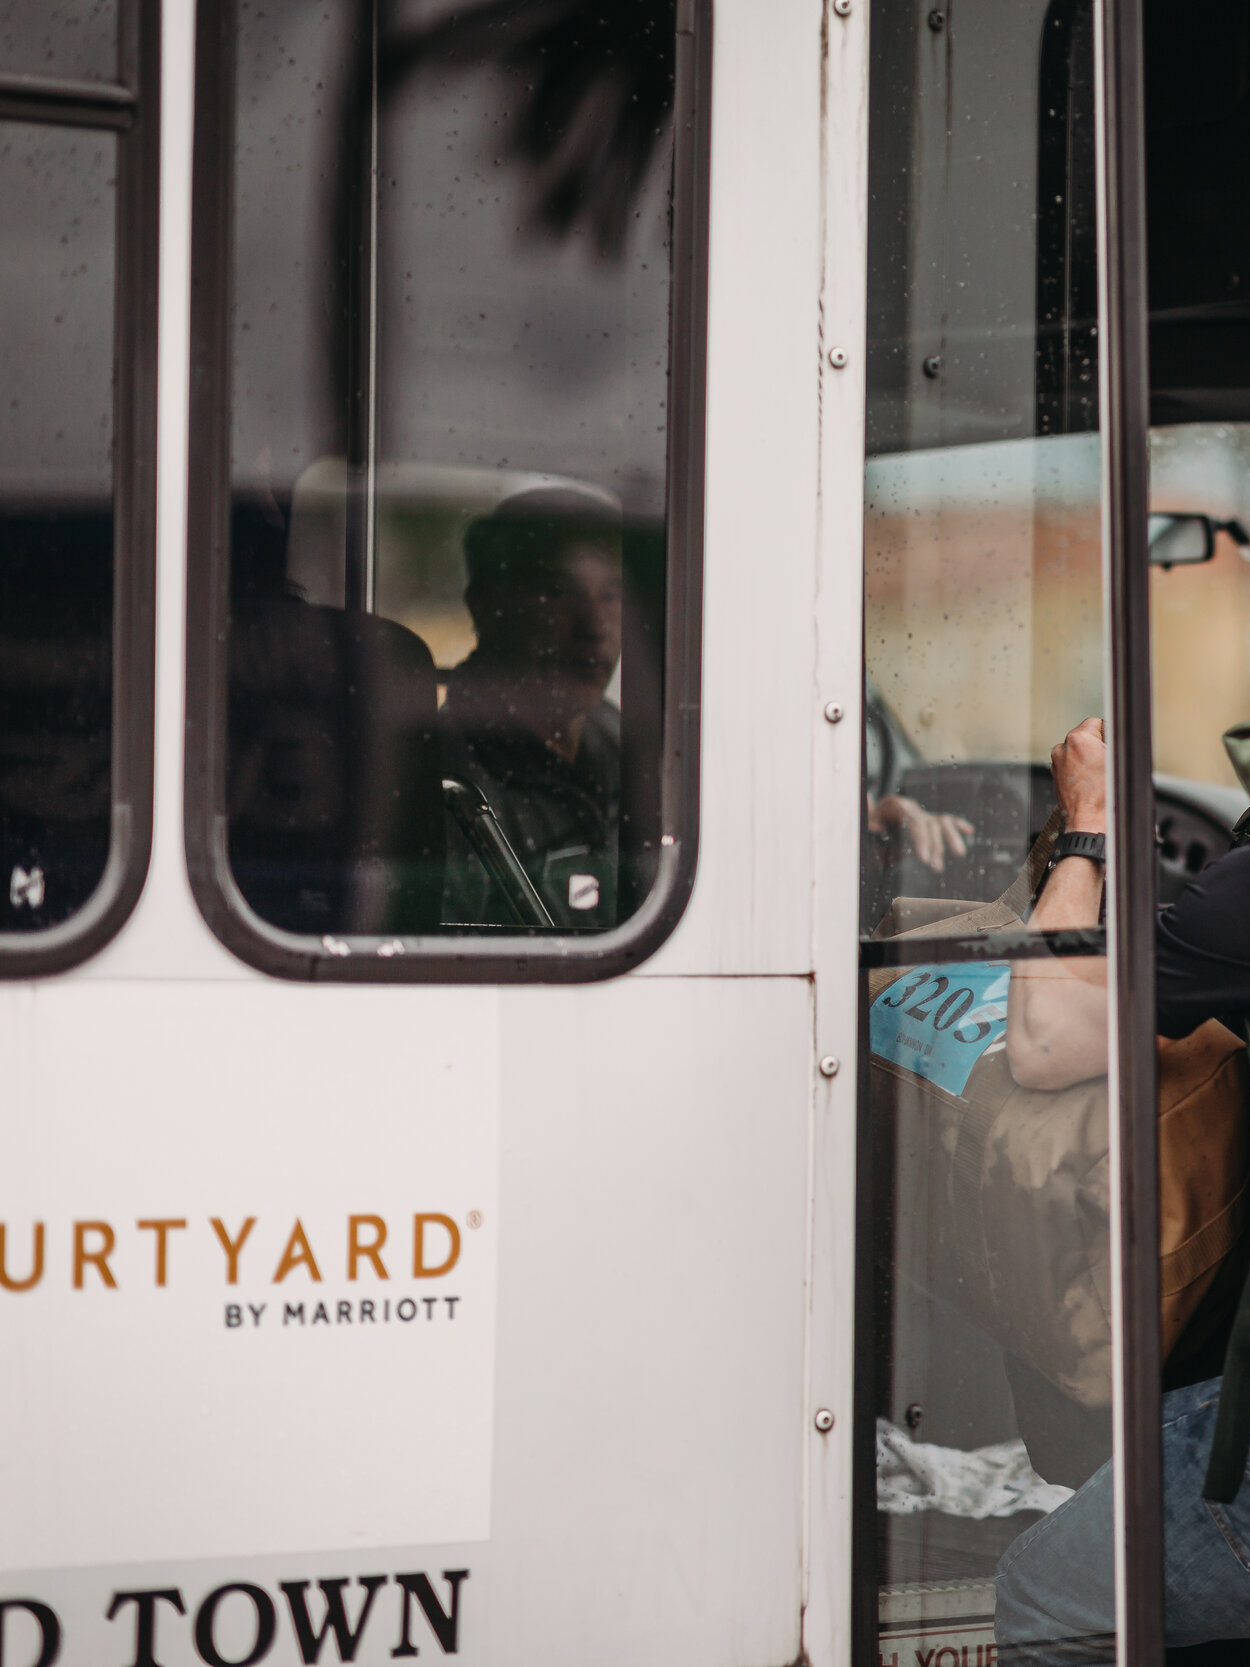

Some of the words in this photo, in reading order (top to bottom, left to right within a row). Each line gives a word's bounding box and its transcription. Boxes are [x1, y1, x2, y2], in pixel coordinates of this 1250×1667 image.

[882, 971, 1007, 1043] 3205
[224, 1303, 266, 1328] BY
[283, 1296, 461, 1326] MARRIOTT
[105, 1568, 470, 1667] TOWN
